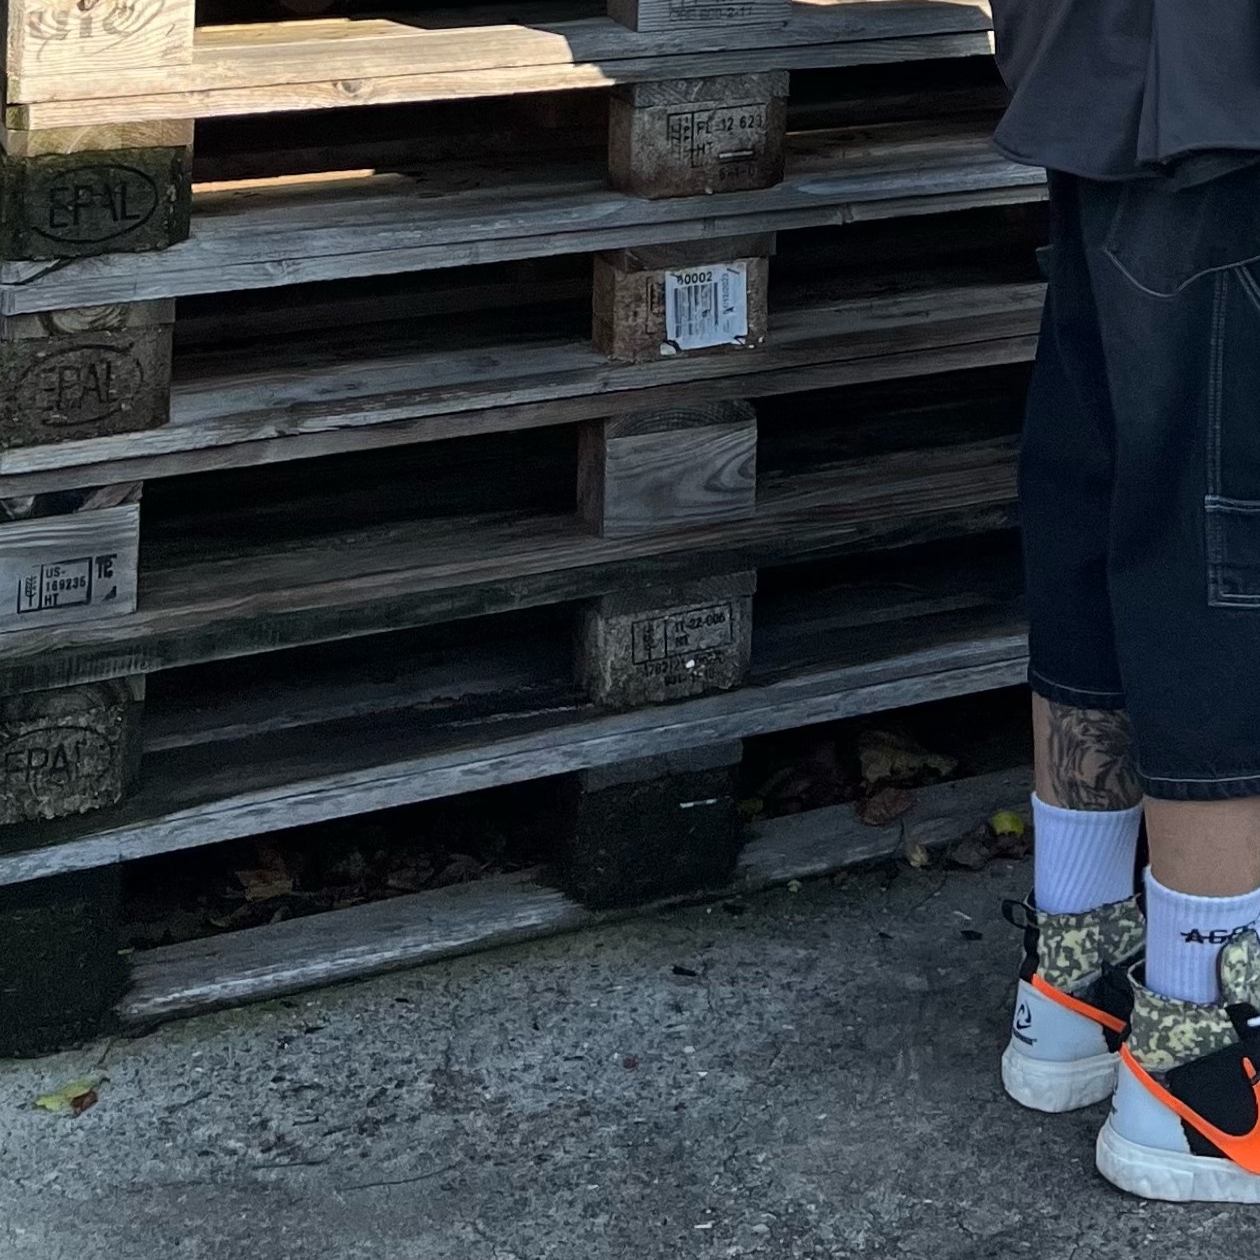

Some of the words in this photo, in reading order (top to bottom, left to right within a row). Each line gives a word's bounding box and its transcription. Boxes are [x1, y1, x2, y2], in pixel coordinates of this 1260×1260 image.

[49, 181, 141, 229] EPAL
[45, 566, 66, 579] US-
[44, 593, 60, 607] HT
